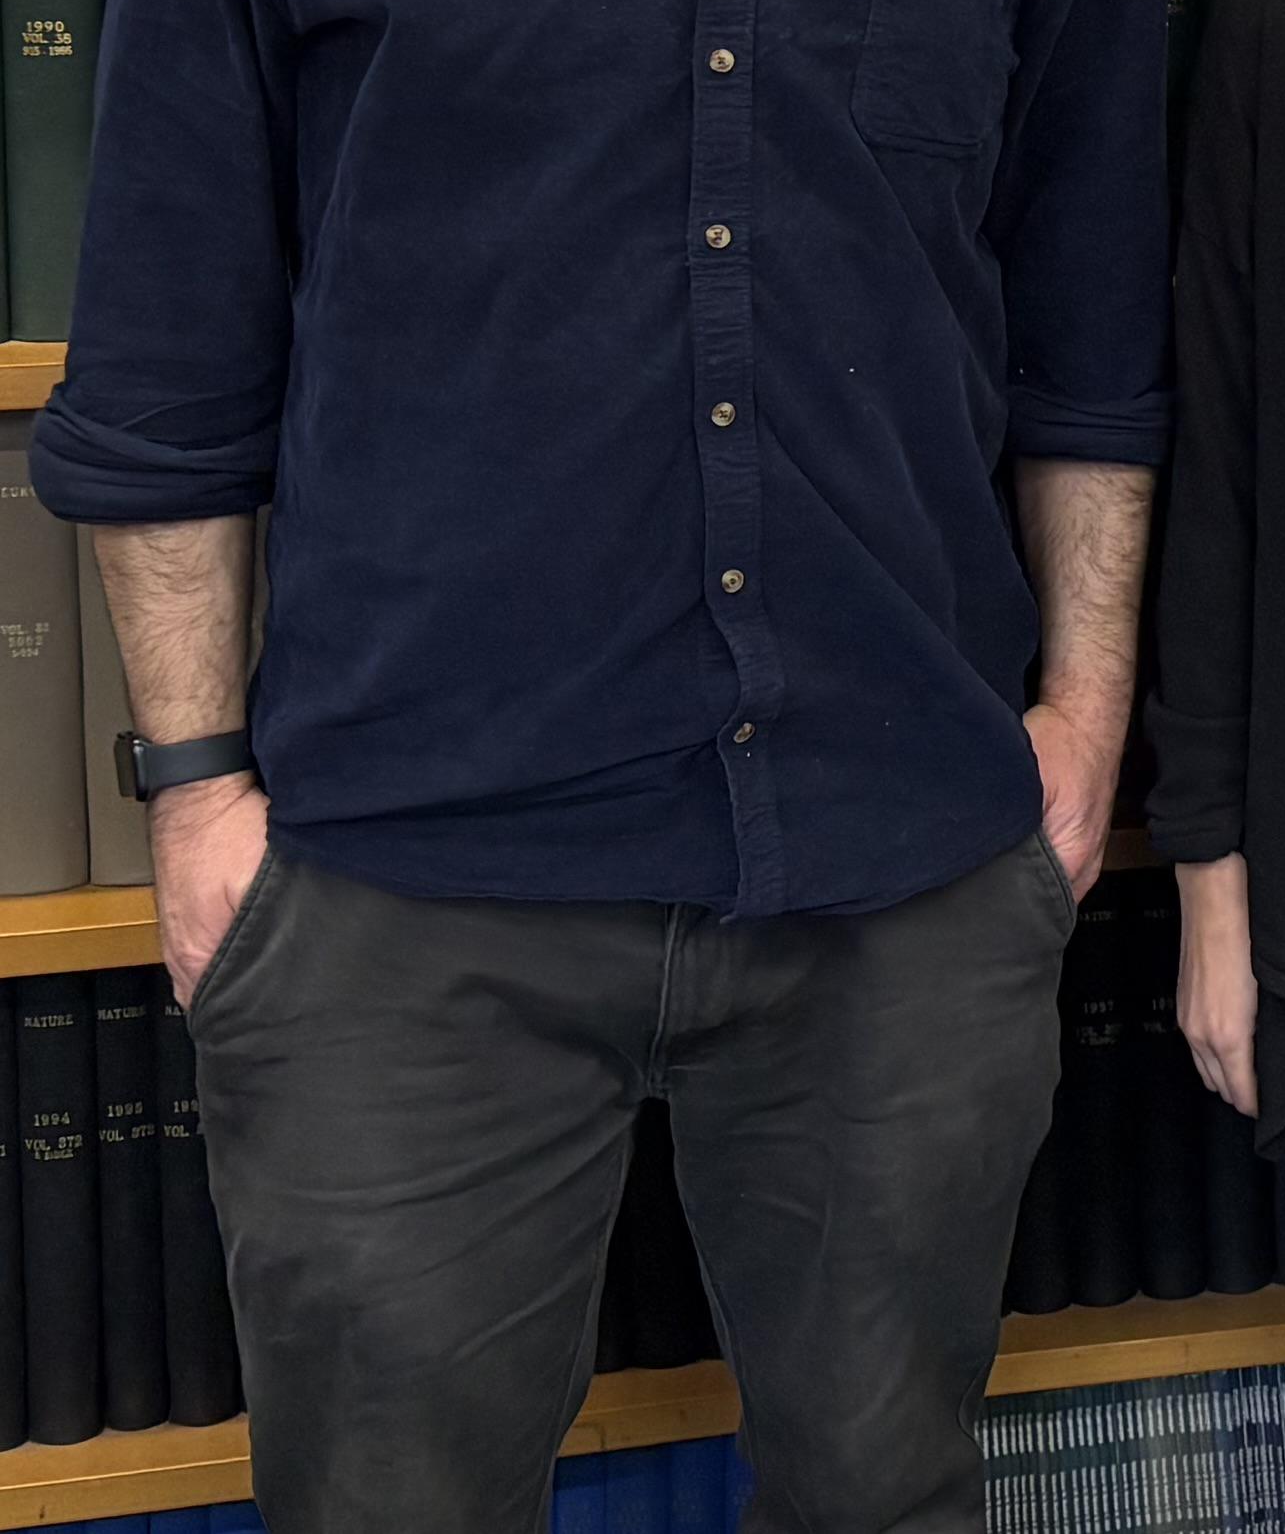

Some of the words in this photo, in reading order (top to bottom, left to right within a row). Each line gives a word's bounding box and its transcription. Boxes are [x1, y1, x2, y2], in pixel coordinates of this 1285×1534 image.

[27, 21, 64, 32] 1990
[55, 33, 71, 44] 38
[98, 1008, 145, 1020] NATURE
[24, 1014, 73, 1027] NATURE
[34, 1113, 70, 1126] 1994
[59, 1135, 82, 1148] 372
